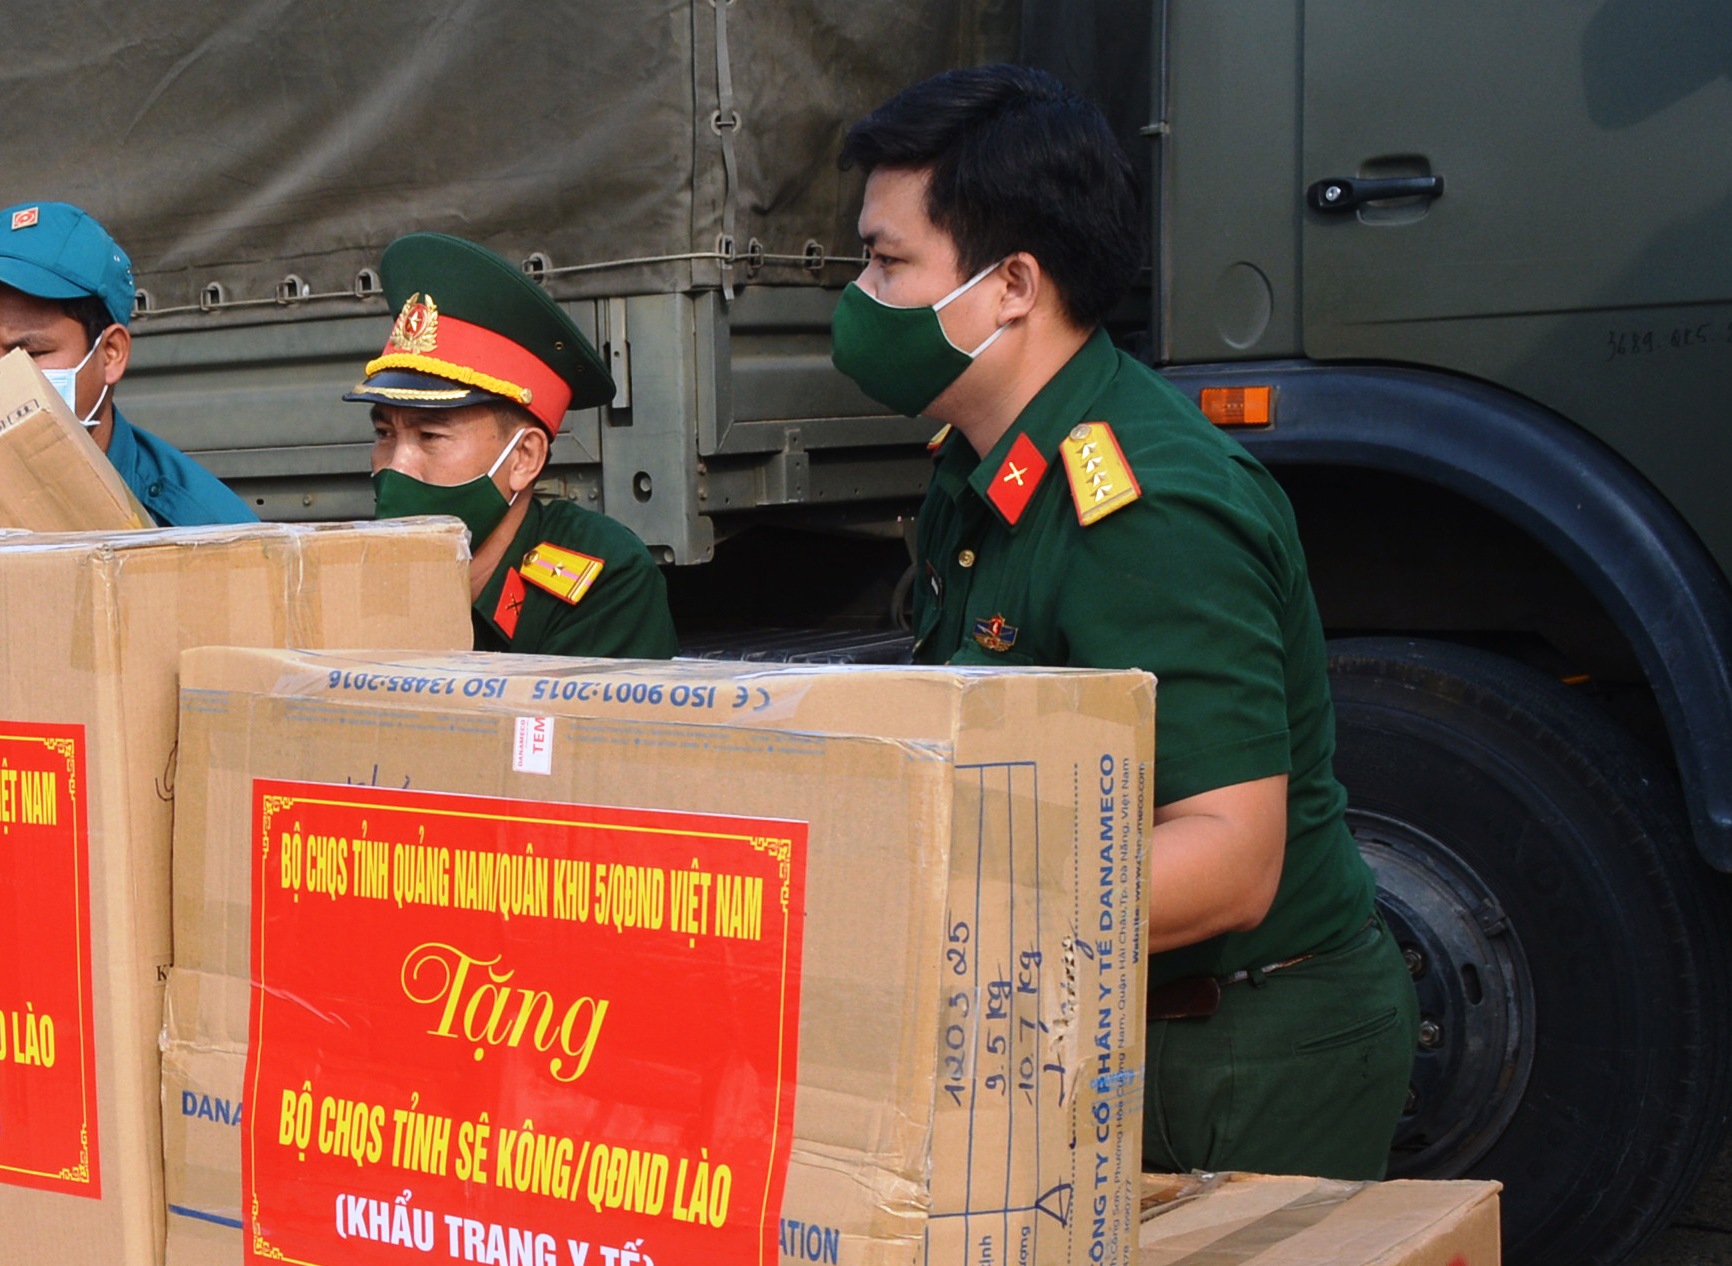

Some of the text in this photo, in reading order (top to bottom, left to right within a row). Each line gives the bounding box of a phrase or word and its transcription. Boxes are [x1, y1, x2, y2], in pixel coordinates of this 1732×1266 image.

[329, 670, 715, 708] ISO 9001:2015 ISO 13485:2016
[533, 718, 546, 753] TEM
[1100, 753, 1114, 931] DANAMECO
[281, 821, 764, 948] BỘ CHQS TỈNH QUẢNG NAM/QUÂN KHU 5/QĐND VIỆT NAM
[1095, 939, 1113, 979] TẾ
[401, 942, 608, 1082] Tặng
[1099, 983, 1111, 1004] Y
[12, 1001, 55, 1068] LÀO
[1095, 1009, 1114, 1093] PHẦN
[1092, 1102, 1110, 1143] CỔ
[279, 1083, 313, 1162] BỘ
[318, 1096, 385, 1167] CHQS
[392, 1095, 452, 1176] TỈNH
[455, 1111, 491, 1185] SÊ
[672, 1147, 732, 1228] LÀO
[1094, 1153, 1109, 1189] TY
[335, 1193, 434, 1252] (KHẨU
